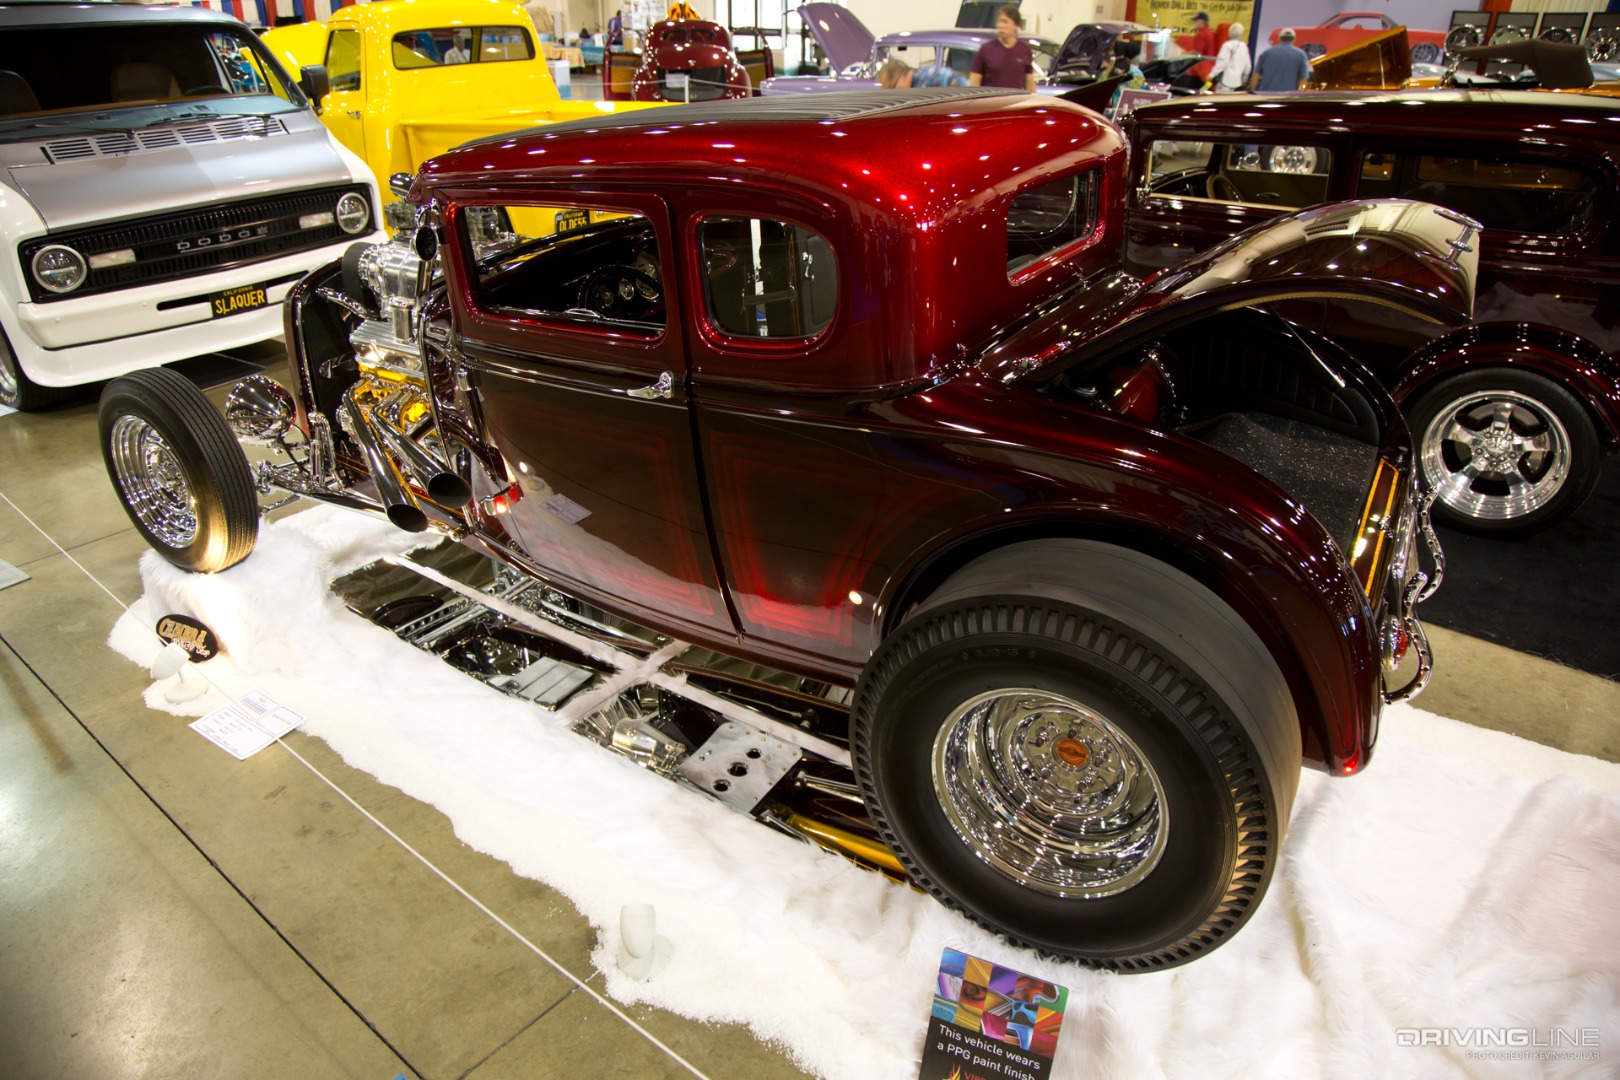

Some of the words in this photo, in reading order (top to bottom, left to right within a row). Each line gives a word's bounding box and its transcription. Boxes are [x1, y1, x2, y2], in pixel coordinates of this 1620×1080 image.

[177, 227, 268, 251] DODGE
[215, 289, 265, 314] SLAQUER
[223, 285, 253, 296] CALIFORNIA
[940, 1024, 962, 1041] This
[964, 1036, 1003, 1056] vehicle
[1006, 1051, 1041, 1070] wears
[937, 1042, 944, 1051] a
[947, 1043, 971, 1060] PPG
[973, 1055, 1001, 1072] paint
[1004, 1065, 1035, 1080] finish
